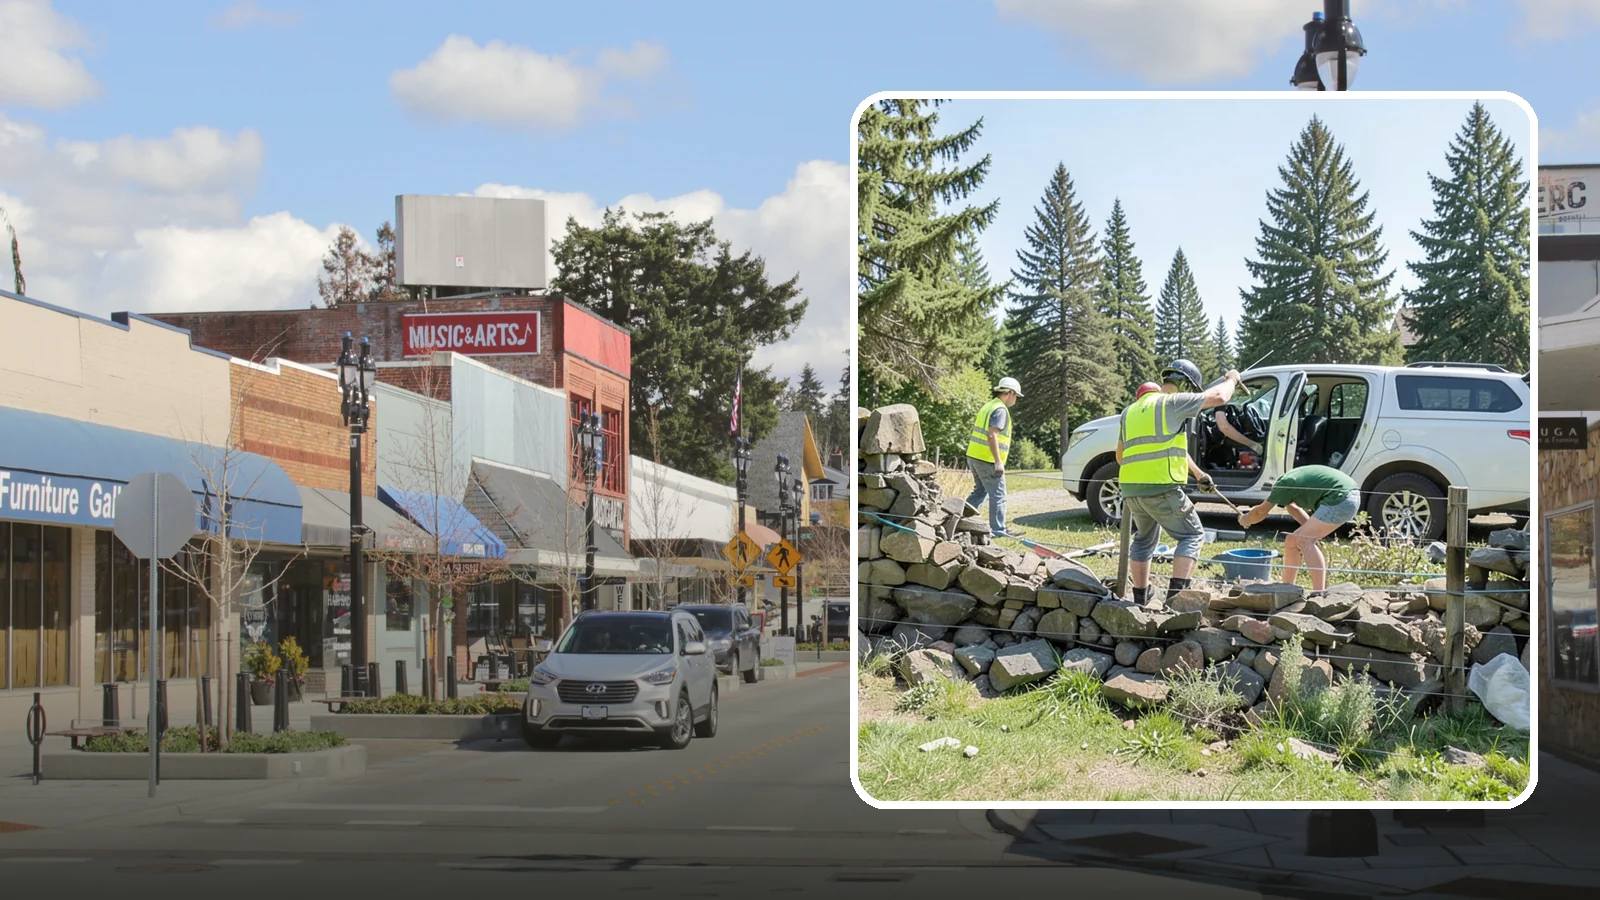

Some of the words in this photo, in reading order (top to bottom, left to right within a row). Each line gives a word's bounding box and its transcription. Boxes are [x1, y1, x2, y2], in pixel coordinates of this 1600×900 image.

[409, 322, 519, 349] MUSIC&ARTS
[0, 471, 79, 515] Furniture
[89, 482, 121, 519] Gal
[453, 563, 479, 574] SUSHI
